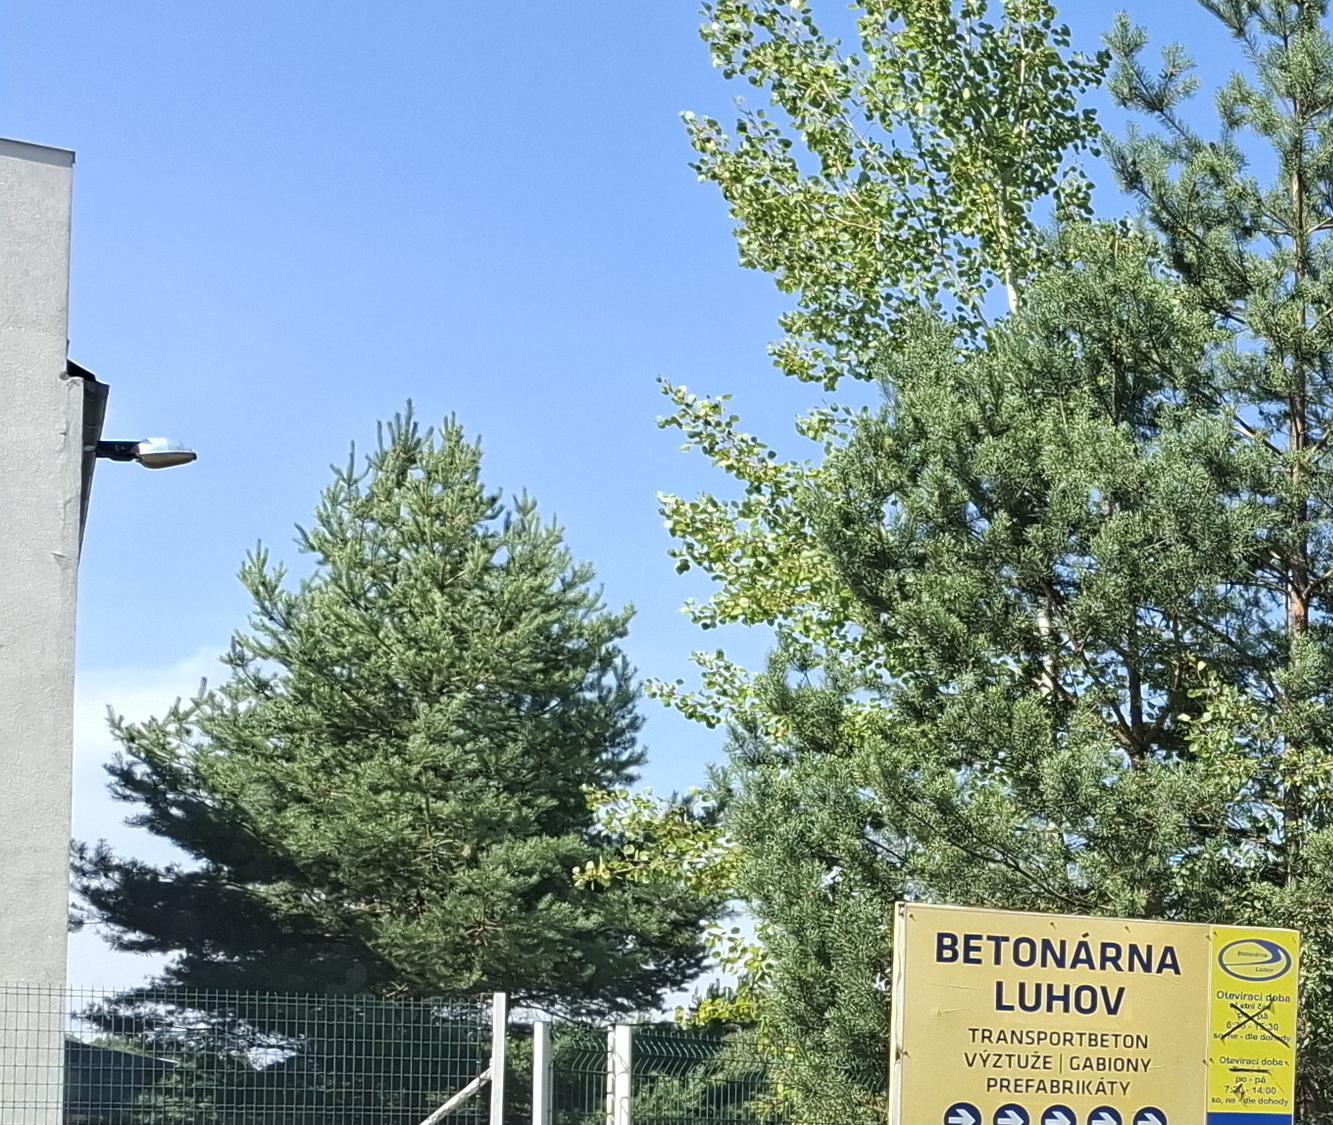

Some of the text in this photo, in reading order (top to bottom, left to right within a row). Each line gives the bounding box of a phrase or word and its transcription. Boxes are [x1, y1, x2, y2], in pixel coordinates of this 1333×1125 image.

[936, 932, 1182, 975] BETONÁRNA
[995, 981, 1126, 1016] LUHOV
[968, 1028, 1149, 1049] TRANSPORTBETON
[964, 1050, 1053, 1070] VÝZTUŽE
[1069, 1056, 1152, 1073] GABIONY
[986, 1077, 1131, 1096] PREFABRIKÁTY
